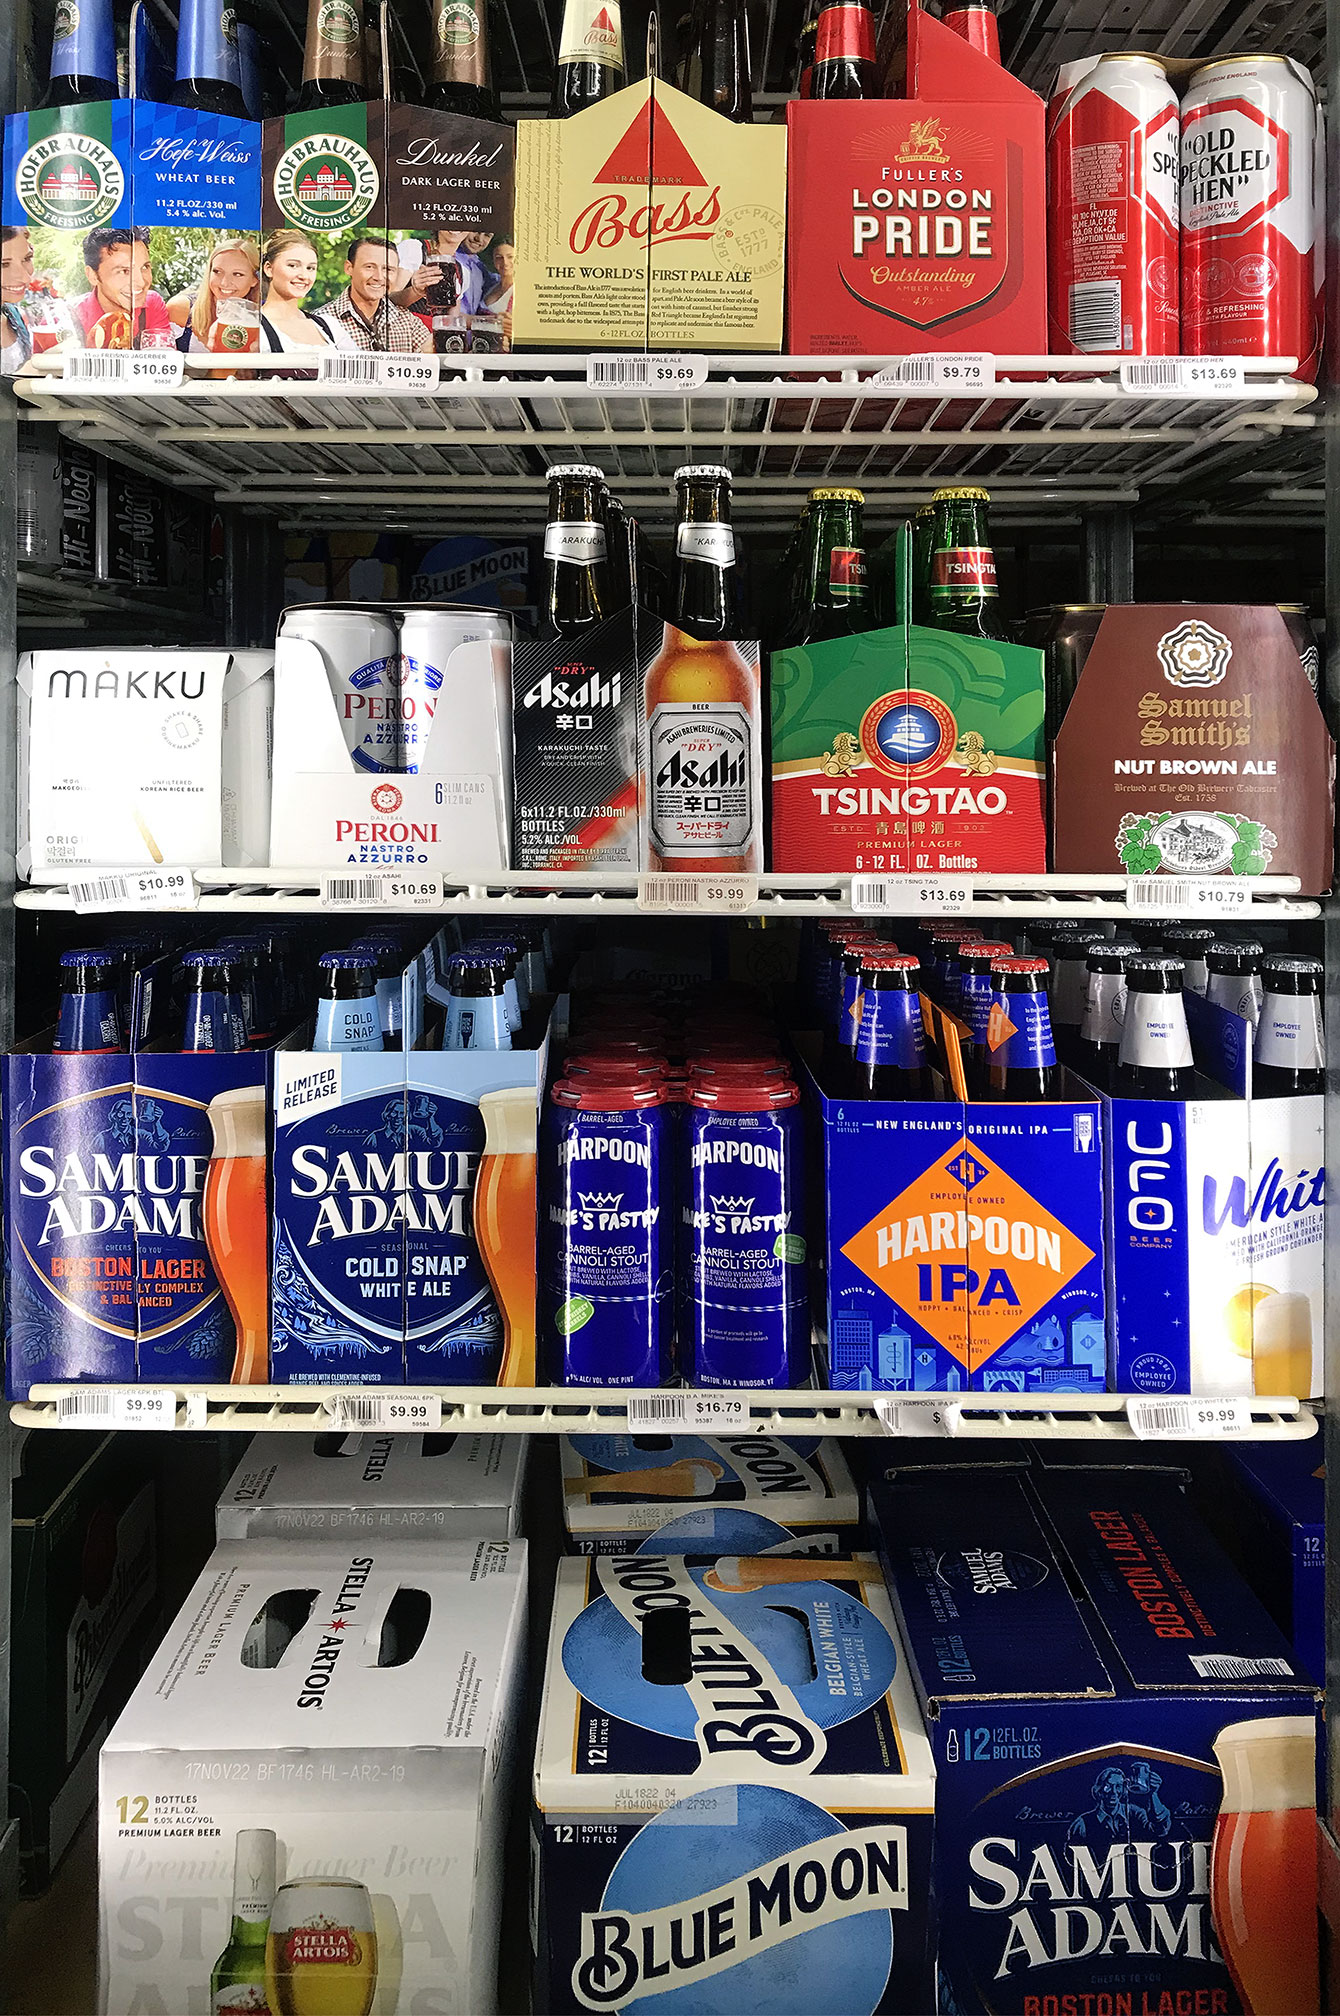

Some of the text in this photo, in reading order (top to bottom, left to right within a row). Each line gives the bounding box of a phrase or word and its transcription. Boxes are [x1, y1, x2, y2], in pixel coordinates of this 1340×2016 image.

[584, 30, 618, 47] Bass
[313, 46, 357, 60] Dunkel
[436, 49, 476, 63] Dunkel
[1227, 71, 1258, 80] ENGLAND
[139, 137, 252, 170] Hefe-Weiss
[395, 137, 504, 168] Dunkel
[278, 138, 375, 196] HOFBRAUHAUS
[155, 173, 237, 185] WHEAT BEER
[882, 167, 963, 183] FULLER'S
[402, 176, 501, 190] DARK LAGER BEER
[853, 188, 992, 210] LONDON
[44, 213, 95, 227] FREISING
[300, 213, 351, 228] FREISING
[568, 185, 721, 254] Bass
[853, 215, 992, 259] PRIDE
[546, 266, 752, 283] THE WORLD'S FIRST PALE ALE
[870, 265, 976, 288] Outstanding
[1213, 303, 1265, 314] REFRESHING
[650, 330, 695, 339] BOTTLES
[133, 363, 177, 375] $10.69
[387, 366, 433, 379] $10.99
[657, 368, 694, 380] $9.69
[943, 366, 980, 378] $9.79
[1191, 367, 1237, 380] $13.69
[411, 550, 525, 600] BLUE MOON
[523, 671, 621, 709] Asahi
[692, 703, 710, 711] BEER
[1137, 691, 1253, 719] Samuel
[556, 714, 593, 731] 辛口
[1139, 719, 1251, 751] Smith's
[657, 749, 745, 788] Asahi
[1114, 759, 1277, 775] NUT BROWN ALE
[684, 796, 721, 812] 辛口
[811, 786, 1007, 816] TSINGTAO
[1174, 793, 1217, 802] Est. 1758
[336, 820, 438, 842] PERONI
[521, 820, 565, 832] BOTTLES
[676, 821, 730, 831] スーパードライ
[875, 820, 945, 836] 青島啤酒
[521, 834, 543, 845] 5.2%
[683, 831, 723, 839] アサヒビール
[360, 845, 414, 853] NASTRO
[857, 840, 962, 848] PREMIUM LAGER
[347, 854, 428, 863] AZZURRO
[138, 875, 184, 891] $10.99
[391, 884, 437, 895] $10.69
[707, 887, 744, 900] $9.99
[920, 889, 966, 901] $13.69
[1198, 890, 1245, 902] $10.79
[344, 1011, 373, 1026] COLD
[1273, 1021, 1301, 1031] EMPLOYEE
[285, 1068, 335, 1095] LIMITED
[283, 1082, 338, 1110] RELEASE
[581, 1114, 624, 1124] BARREL-AGED
[837, 1108, 845, 1120] 6
[876, 1120, 1048, 1135] NEW ENGLAND'S ORIGINAL IPA
[690, 1141, 781, 1174] HARPOON
[930, 1192, 1005, 1205] EMPLOYEE OWNED
[876, 1210, 1061, 1274] HARPOON
[1130, 1235, 1173, 1243] BEER
[381, 1242, 429, 1252] SEASONAL
[568, 1245, 636, 1256] BARREL-AGED
[701, 1247, 768, 1258] BARREL-AGED
[345, 1255, 468, 1277] COLD SNAP
[610, 1253, 649, 1267] STOUT
[51, 1256, 206, 1279] BOSTON LAGER
[154, 1282, 204, 1294] COMPLEX
[360, 1281, 451, 1298] WHITE ALE
[916, 1263, 1021, 1307] IPA
[1134, 1371, 1172, 1381] EMPLOYEE
[1140, 1379, 1166, 1388] OWNED
[126, 1399, 163, 1411] $9.99
[390, 1405, 427, 1417] $9.99
[696, 1402, 742, 1414] $16.79
[1198, 1410, 1235, 1423] $9.99
[361, 1436, 395, 1482] STELLA
[579, 1541, 594, 1554] 12
[960, 1547, 997, 1594] SAMUEL
[983, 1551, 1018, 1590] ADAMS
[1088, 1510, 1195, 1639] BOSTON LAGER
[296, 1556, 374, 1709] STELLA ARTOIS
[813, 1601, 848, 1697] BELGIAN WHITE
[589, 1717, 599, 1743] BOTTLES
[964, 1727, 991, 1761] 12
[588, 1748, 607, 1766] 12
[993, 1743, 1041, 1760] BOTTLES
[115, 1795, 198, 1824] 12 BOTTLES
[118, 1828, 222, 1838] PREMIUM LAGER BEER
[554, 1825, 618, 1843] 12 BOTTLES
[581, 1836, 618, 1844] 12 FL OZ
[576, 1839, 900, 2004] BLUE MOON
[294, 1935, 348, 1947] STELLA
[292, 1946, 349, 1958] ARTOIS
